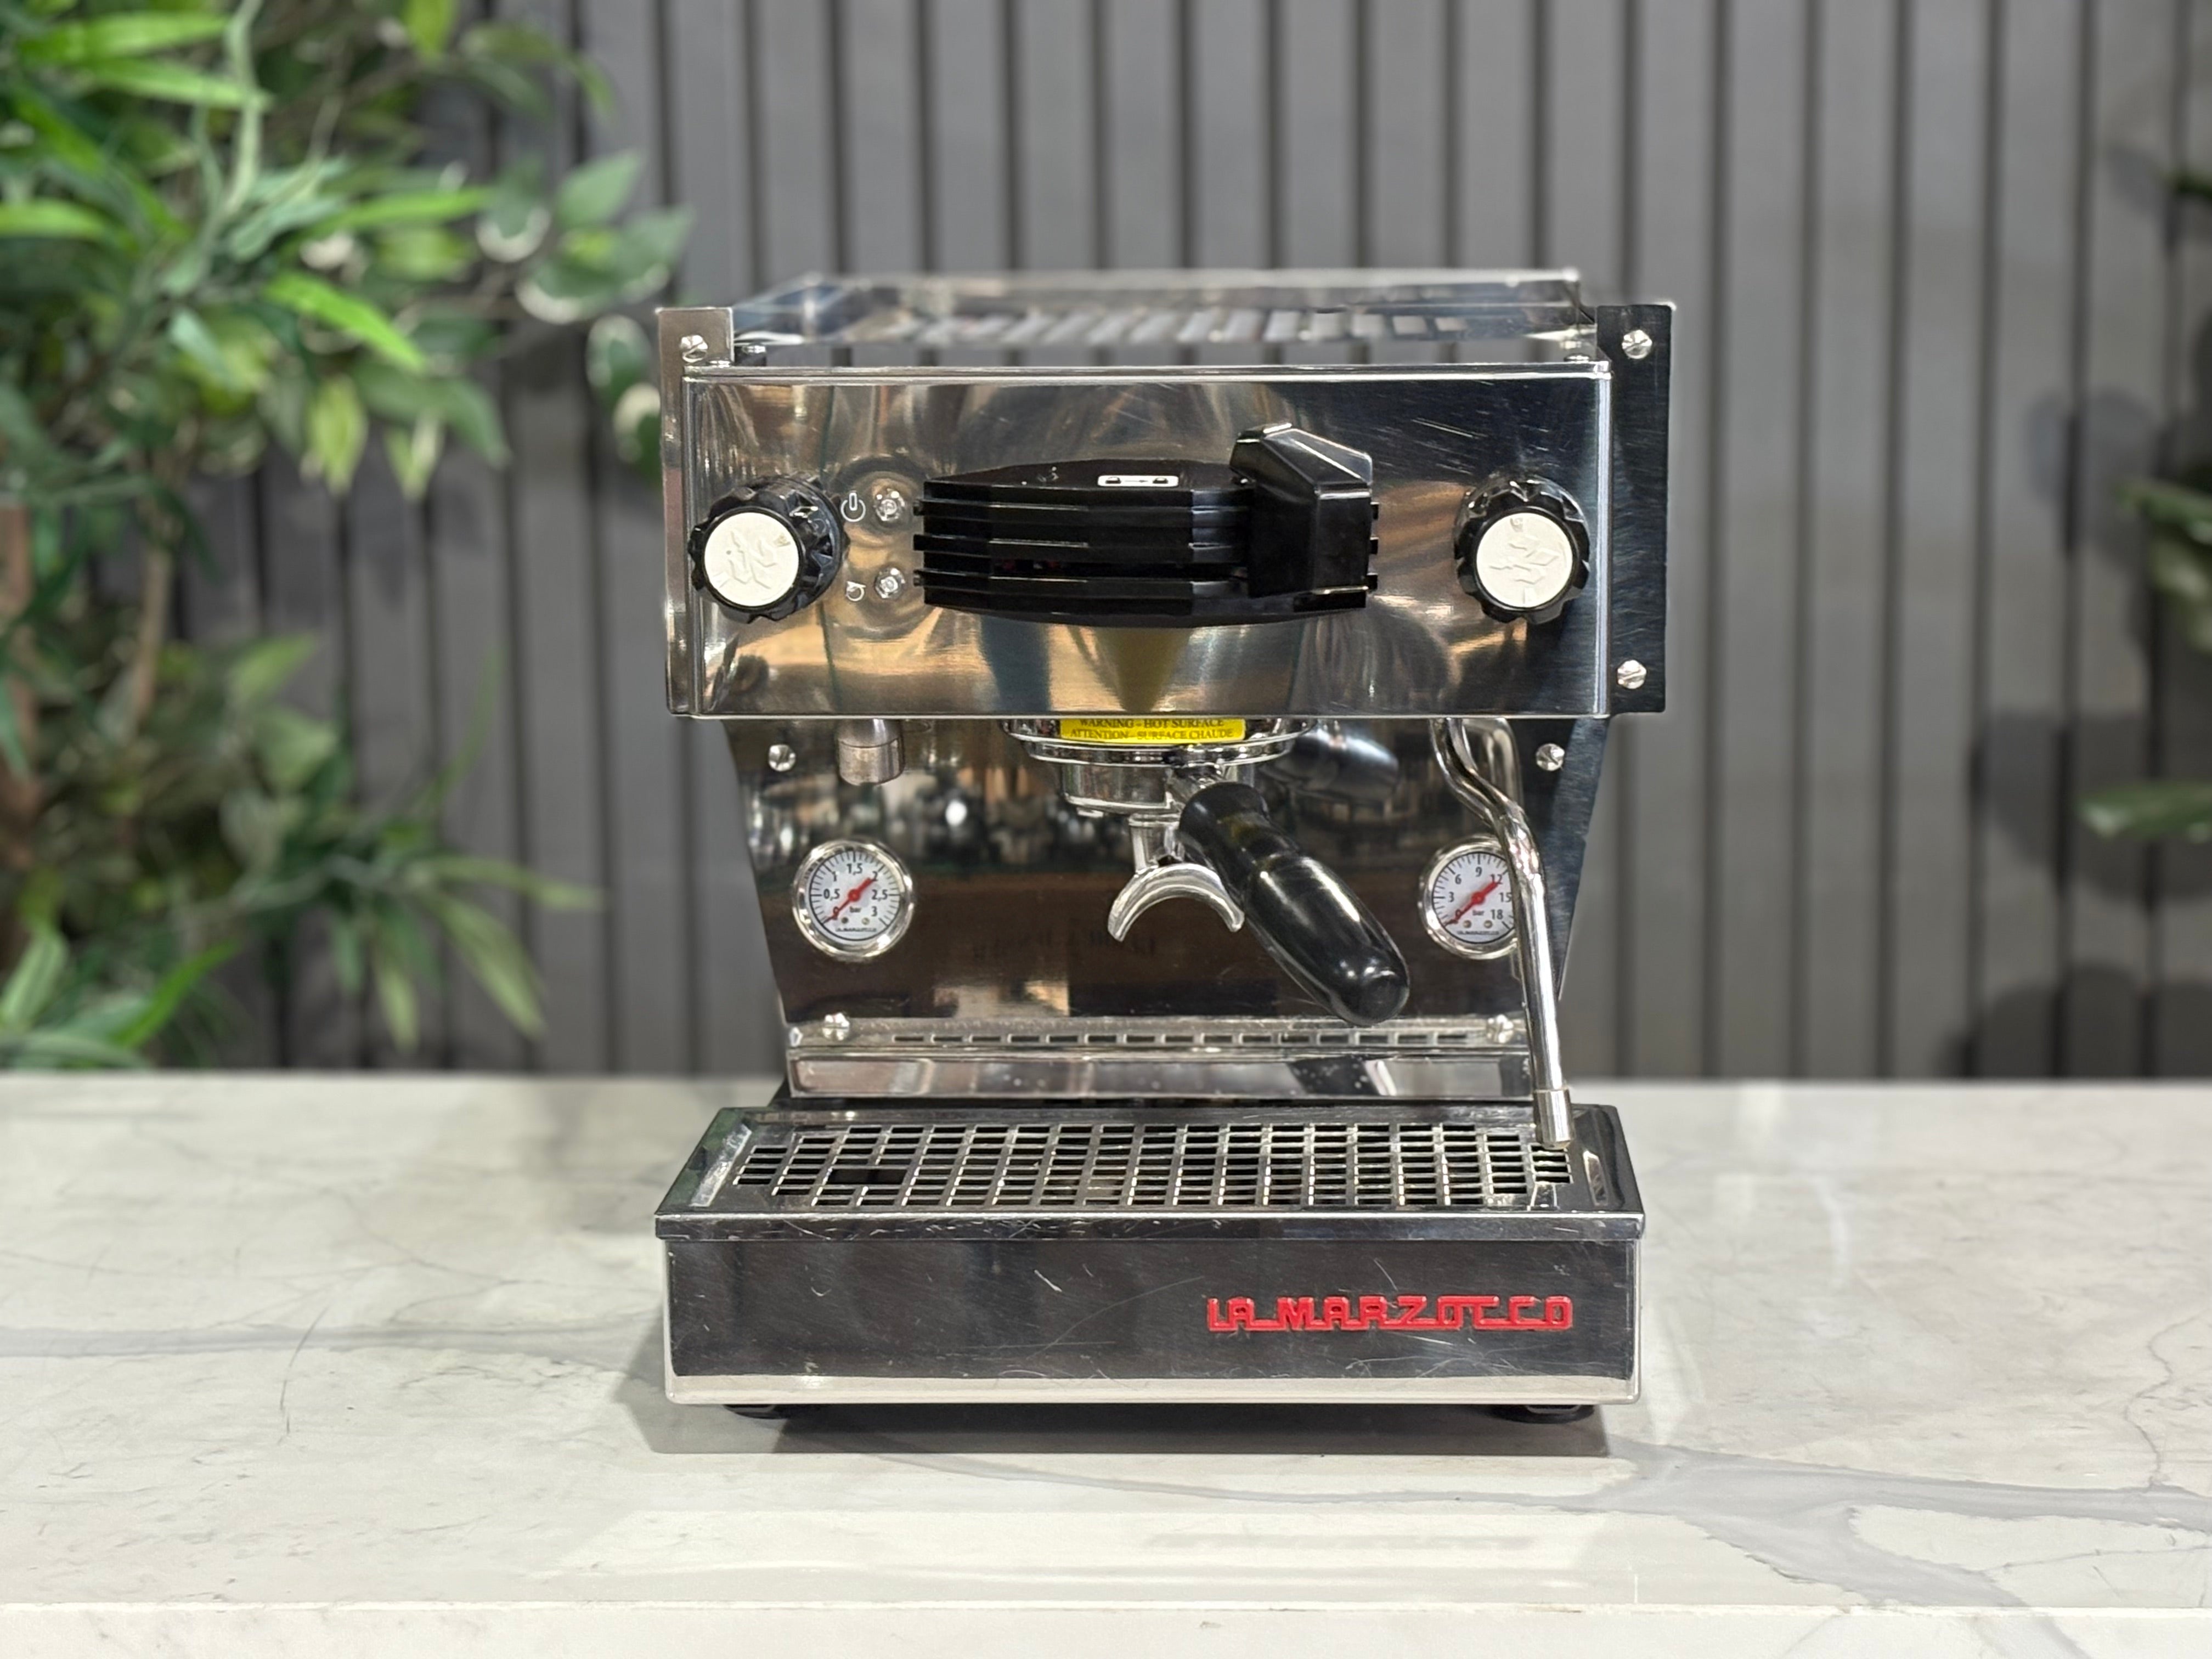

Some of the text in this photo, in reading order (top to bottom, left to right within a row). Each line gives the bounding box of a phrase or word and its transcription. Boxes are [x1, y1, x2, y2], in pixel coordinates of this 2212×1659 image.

[1079, 719, 1135, 729] WARNING
[1144, 719, 1170, 729] HOT
[1171, 719, 1224, 729] SURFACE
[1070, 729, 1129, 739] ATTENTION
[1137, 730, 1187, 740] SURFACE
[1189, 728, 1234, 740] CHAUDE
[847, 863, 863, 876] 1,5
[1475, 867, 1482, 877] 9
[832, 871, 837, 882] 1
[872, 871, 878, 882] 2
[1455, 874, 1462, 884] 6
[1490, 873, 1503, 884] 12
[823, 889, 840, 900] 0,5
[871, 889, 888, 901] 2,5
[1448, 892, 1454, 902] 3
[1499, 891, 1512, 903] 15
[872, 906, 877, 916] 3
[1491, 910, 1503, 919] 18
